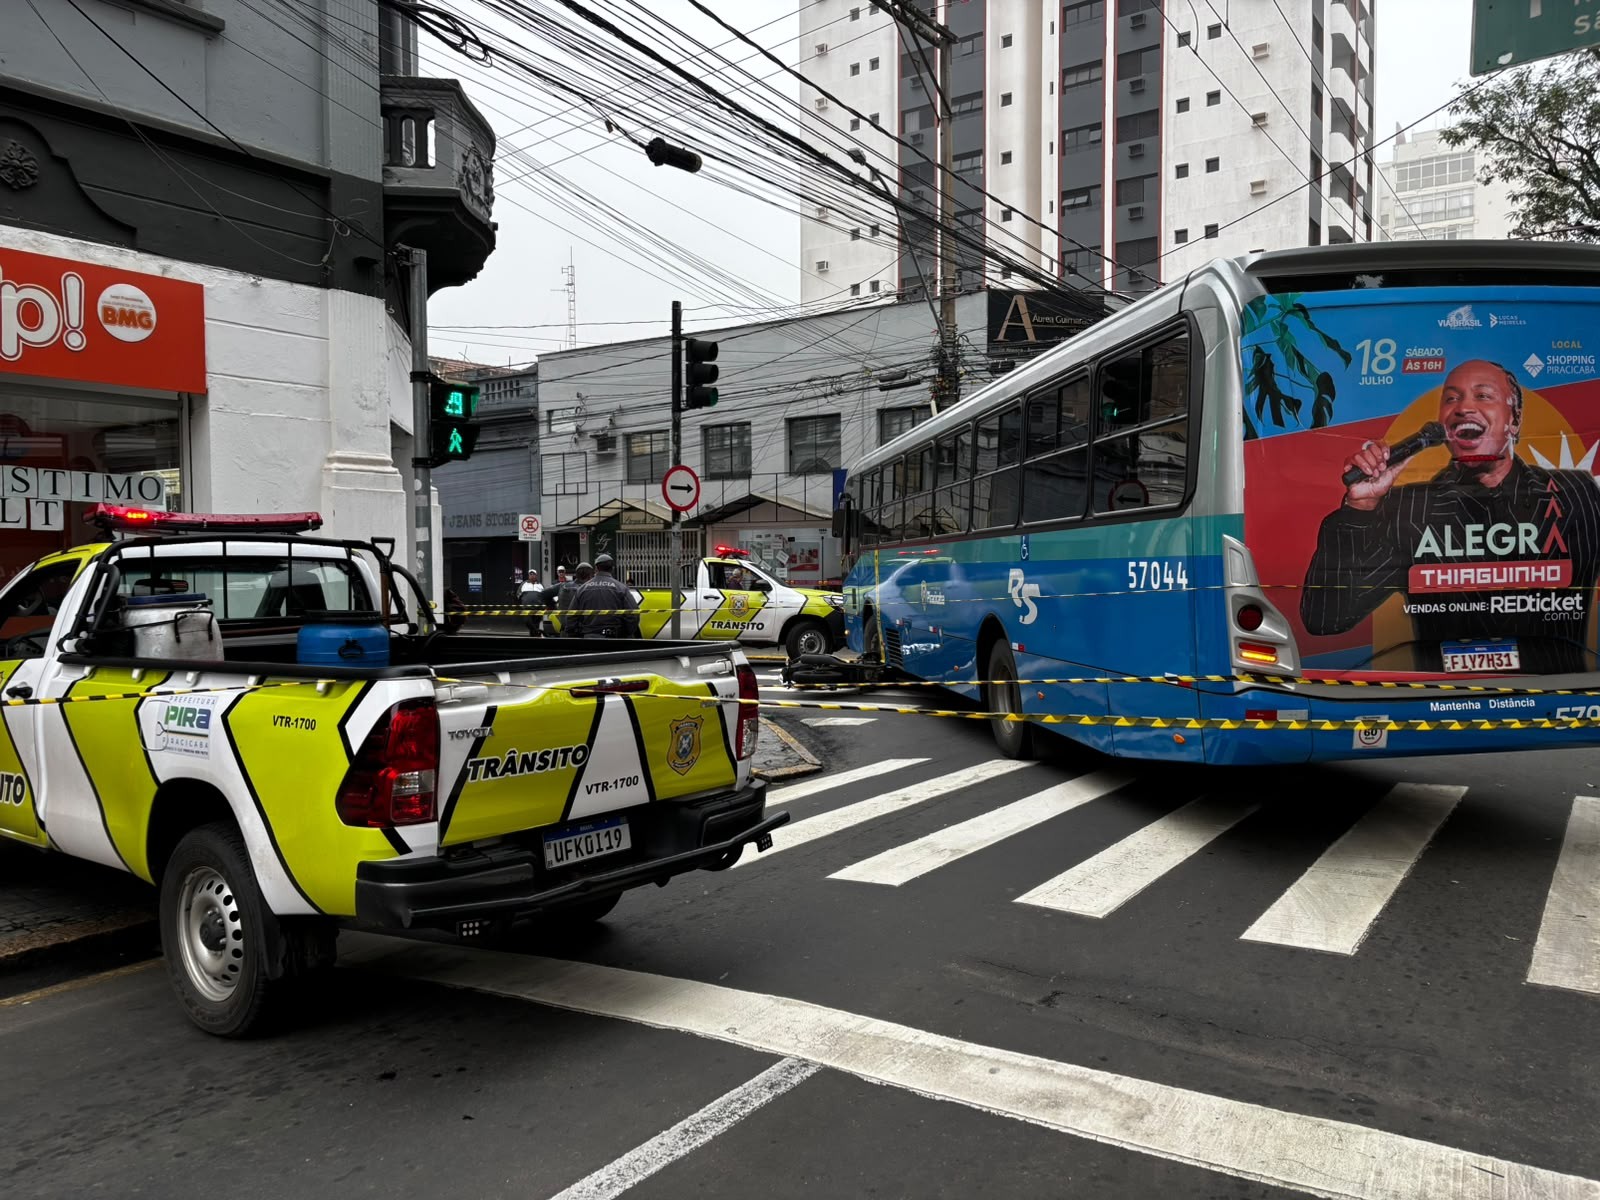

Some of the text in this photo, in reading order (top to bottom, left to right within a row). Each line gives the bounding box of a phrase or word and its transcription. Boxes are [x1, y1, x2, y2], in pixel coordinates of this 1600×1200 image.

[101, 305, 154, 331] BMG
[1405, 346, 1443, 357] SÁBADO
[1551, 340, 1583, 349] LOCAL
[1355, 338, 1397, 375] 18
[1546, 355, 1596, 365] SHOPPING
[1405, 360, 1442, 371] ÀS 16H
[1546, 365, 1596, 375] PIRACICABA
[1358, 376, 1394, 386] JULHO
[11, 467, 162, 501] STIMO
[449, 513, 482, 529] JEANS
[485, 511, 518, 527] STORE
[1128, 561, 1188, 591] 57044
[1420, 565, 1561, 586] THIAGUINHO
[1403, 592, 1584, 614] VENDAS ONLINE: REDticket
[1541, 611, 1586, 621] .com.br
[711, 619, 765, 631] TRÂNSITO
[1450, 652, 1513, 670] FIY7H31
[1430, 697, 1536, 712] Mantenha Distância
[273, 714, 317, 731] VTR-1700
[448, 727, 495, 740] TOYOTA
[467, 744, 589, 782] TRÂNSITO
[585, 775, 639, 795] VTR-1700
